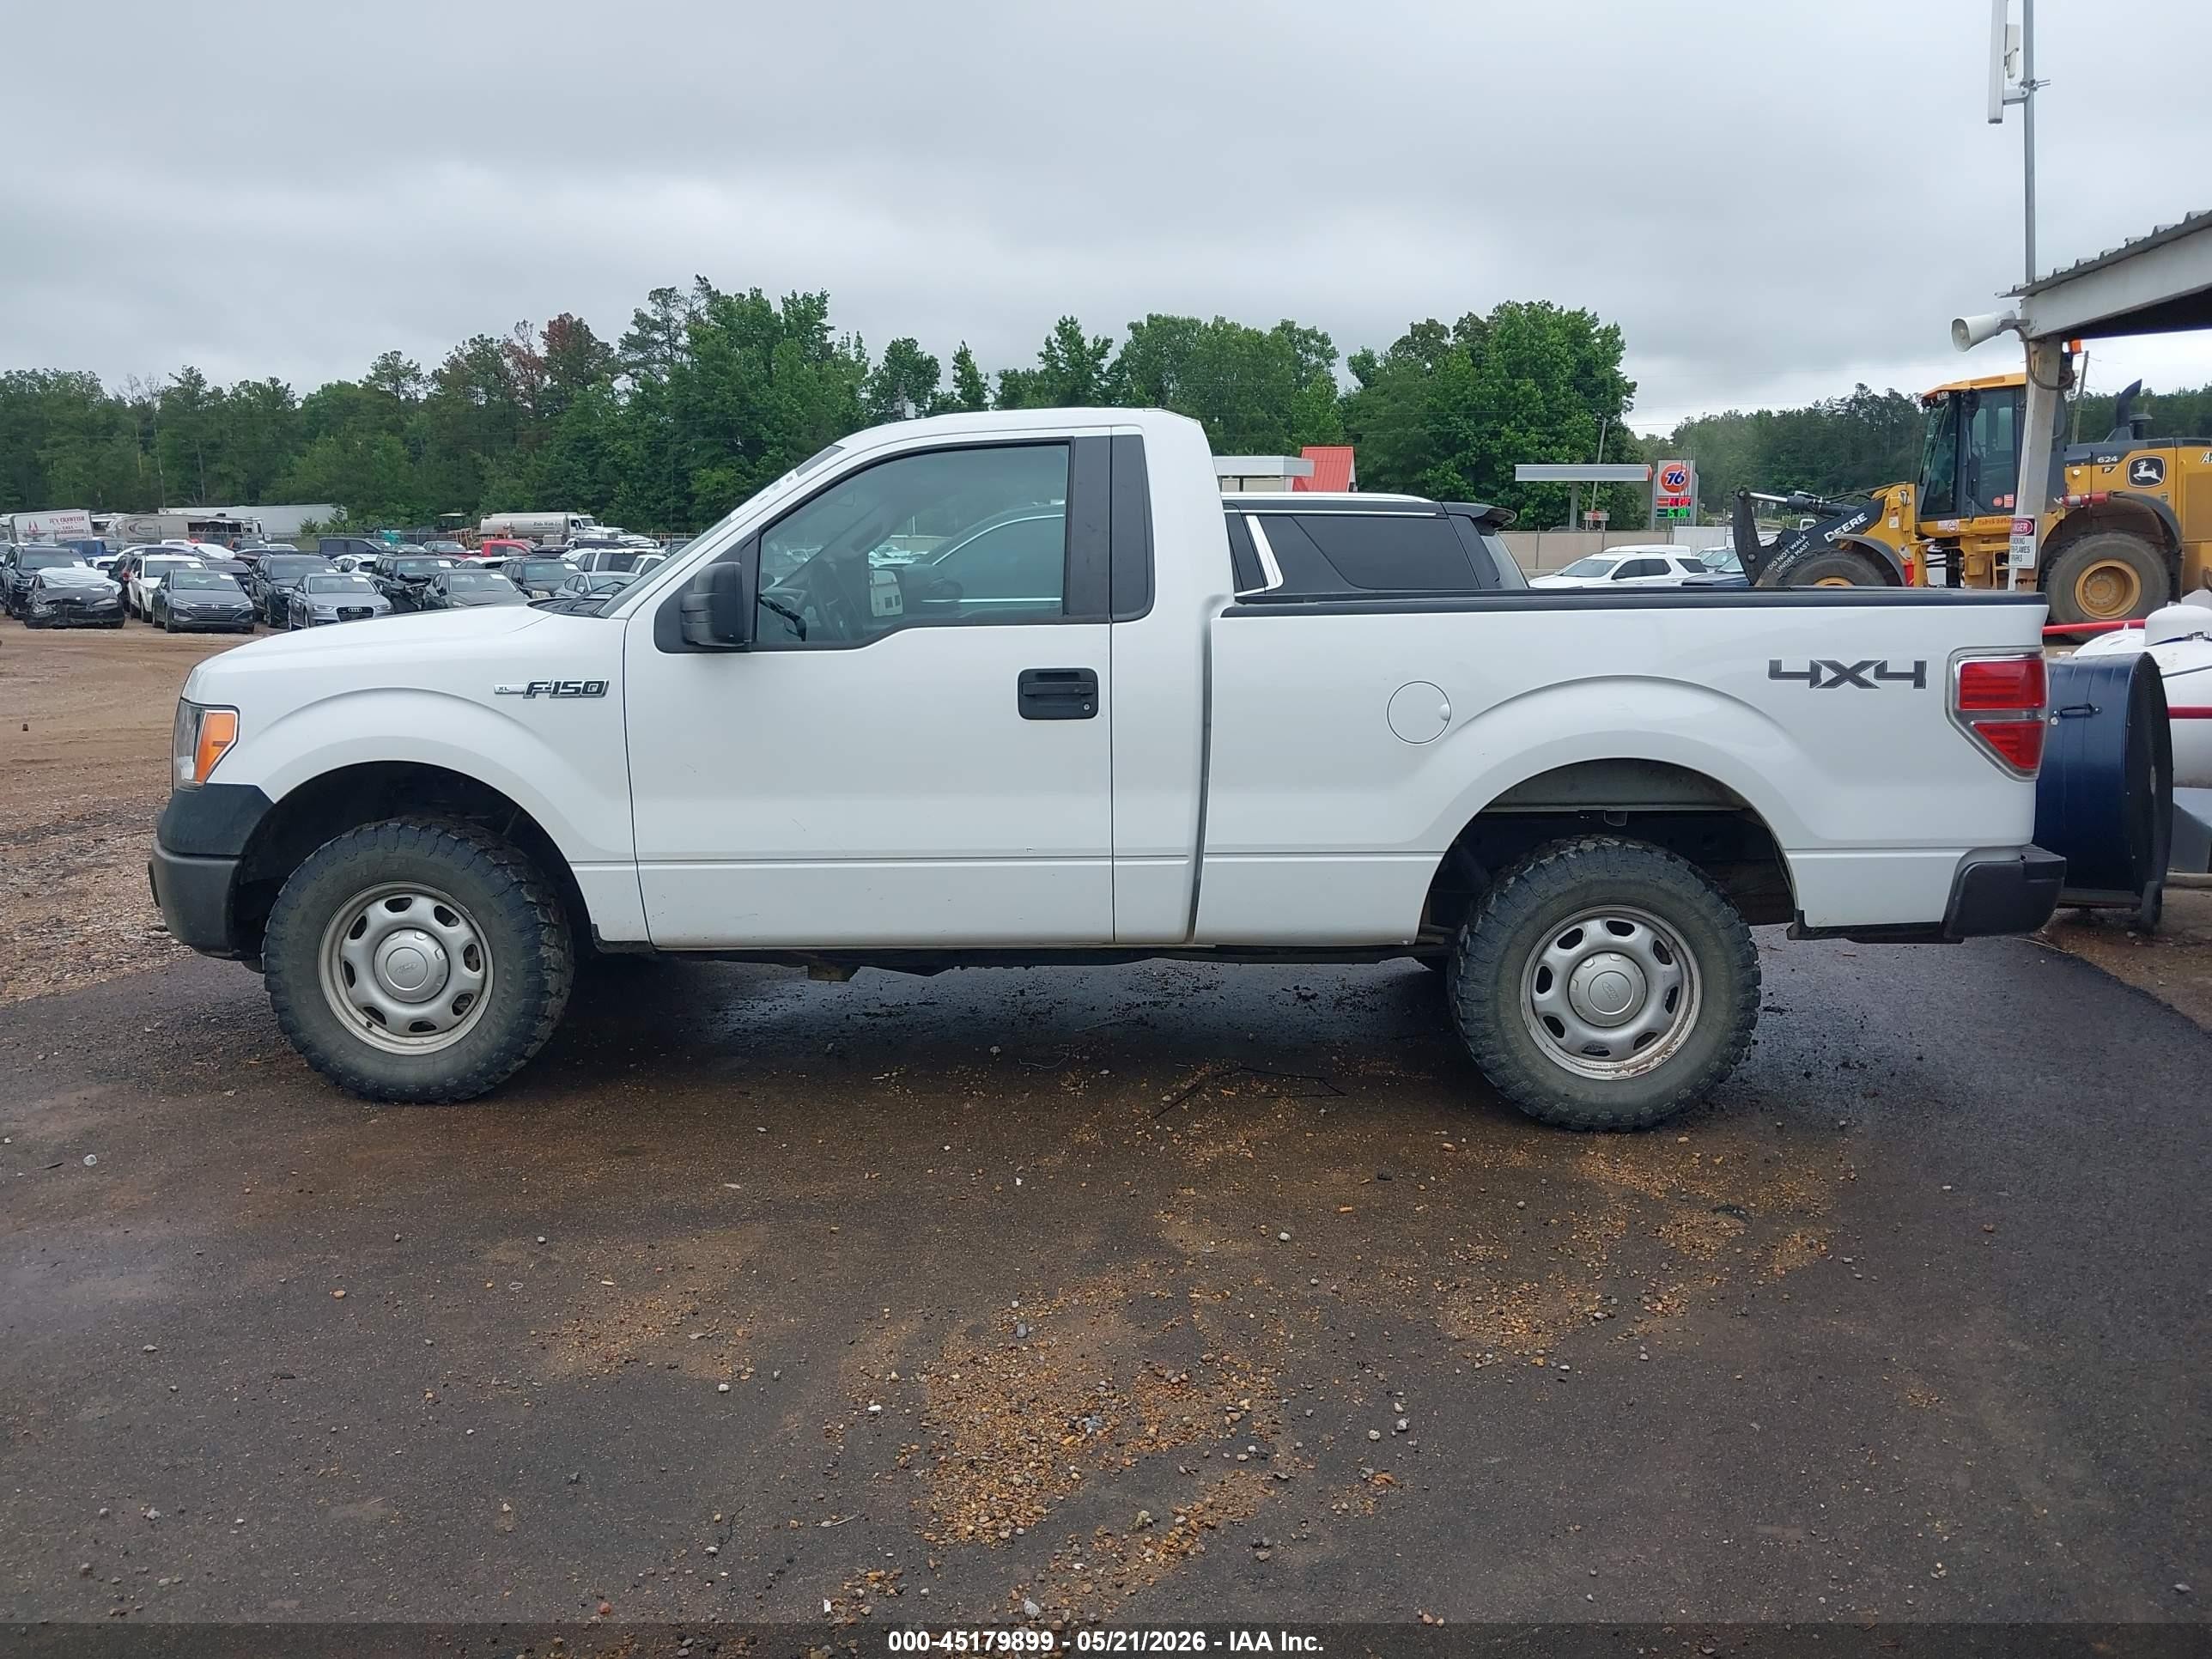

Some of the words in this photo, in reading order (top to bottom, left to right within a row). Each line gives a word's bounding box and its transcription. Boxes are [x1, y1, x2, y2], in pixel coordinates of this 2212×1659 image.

[2097, 455, 2118, 464] 624
[1664, 469, 1686, 487] 76
[1823, 512, 1869, 543] DEERE
[1767, 560, 1778, 570] DO
[1778, 549, 1790, 562] NOT
[1790, 533, 1808, 550] WALK
[1775, 555, 1796, 573] UNDER
[1795, 541, 1811, 556] MAST
[523, 678, 610, 700] F-150
